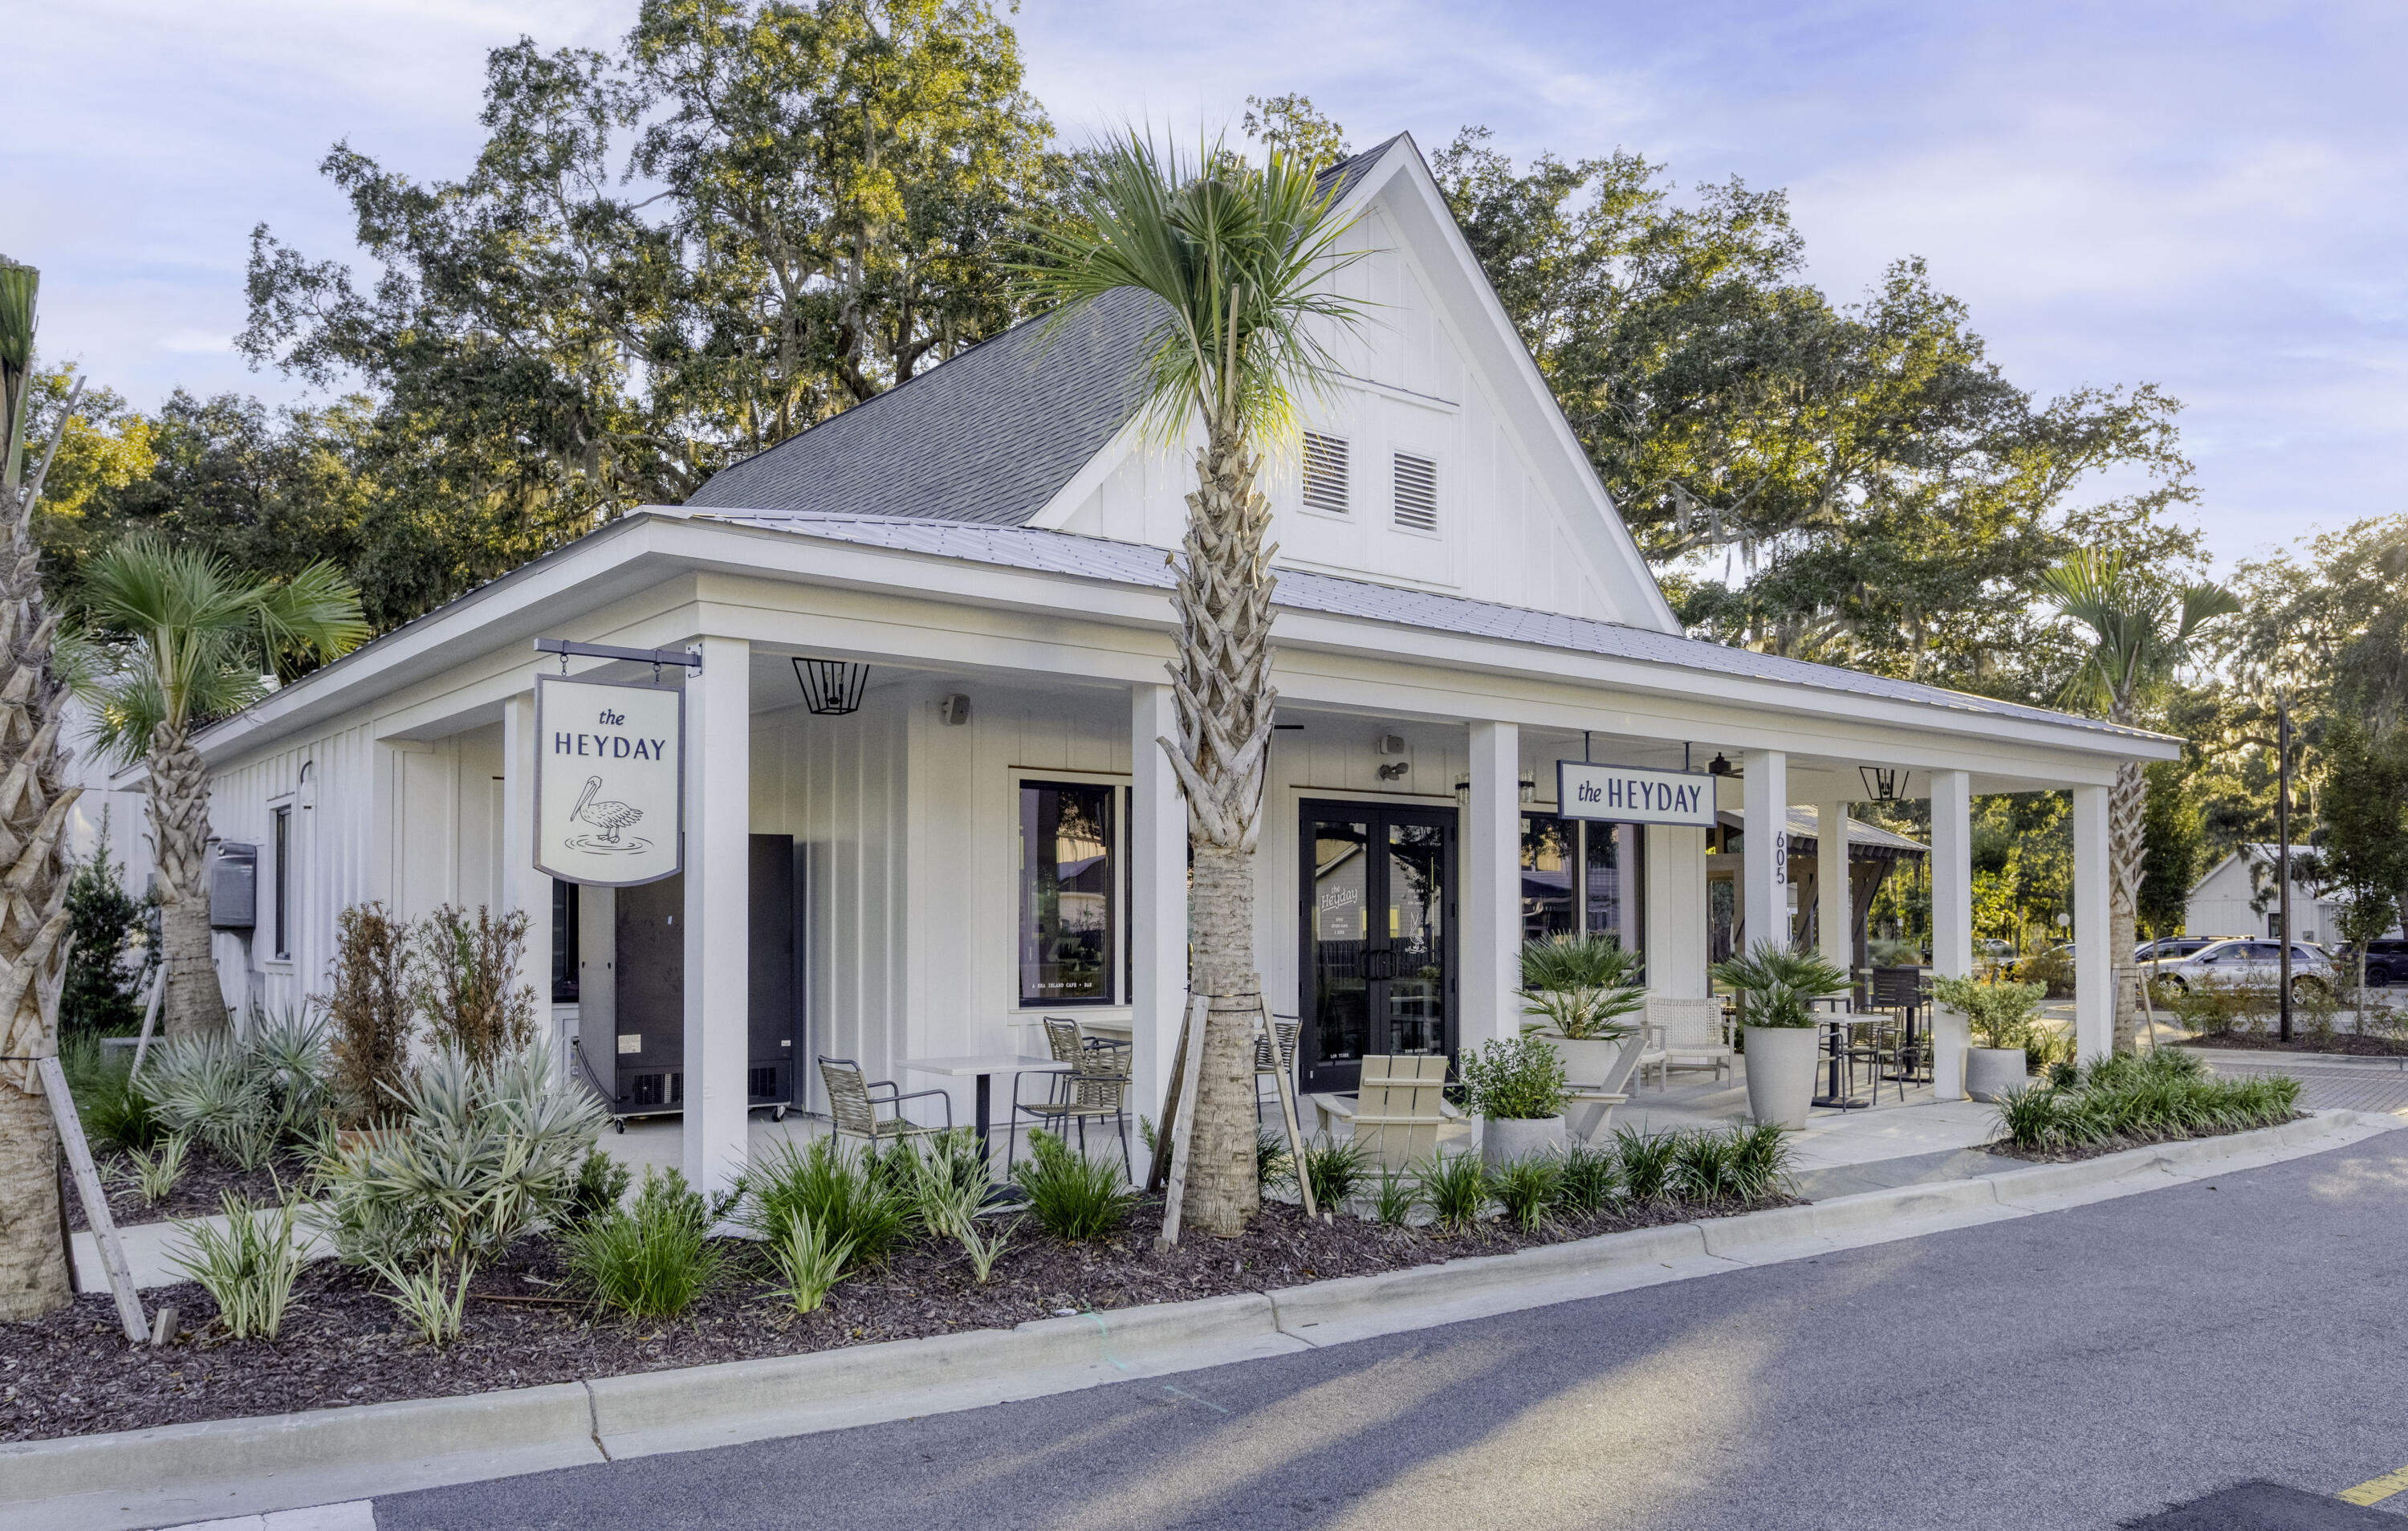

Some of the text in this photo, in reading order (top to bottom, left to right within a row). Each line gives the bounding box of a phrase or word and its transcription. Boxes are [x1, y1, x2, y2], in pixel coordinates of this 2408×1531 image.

[599, 709, 624, 725] the
[555, 732, 665, 760] HEYDAY
[1578, 778, 1701, 813] the HEYDAY
[1776, 831, 1785, 884] 605
[1321, 887, 1357, 910] Heyday
[1331, 885, 1340, 894] the
